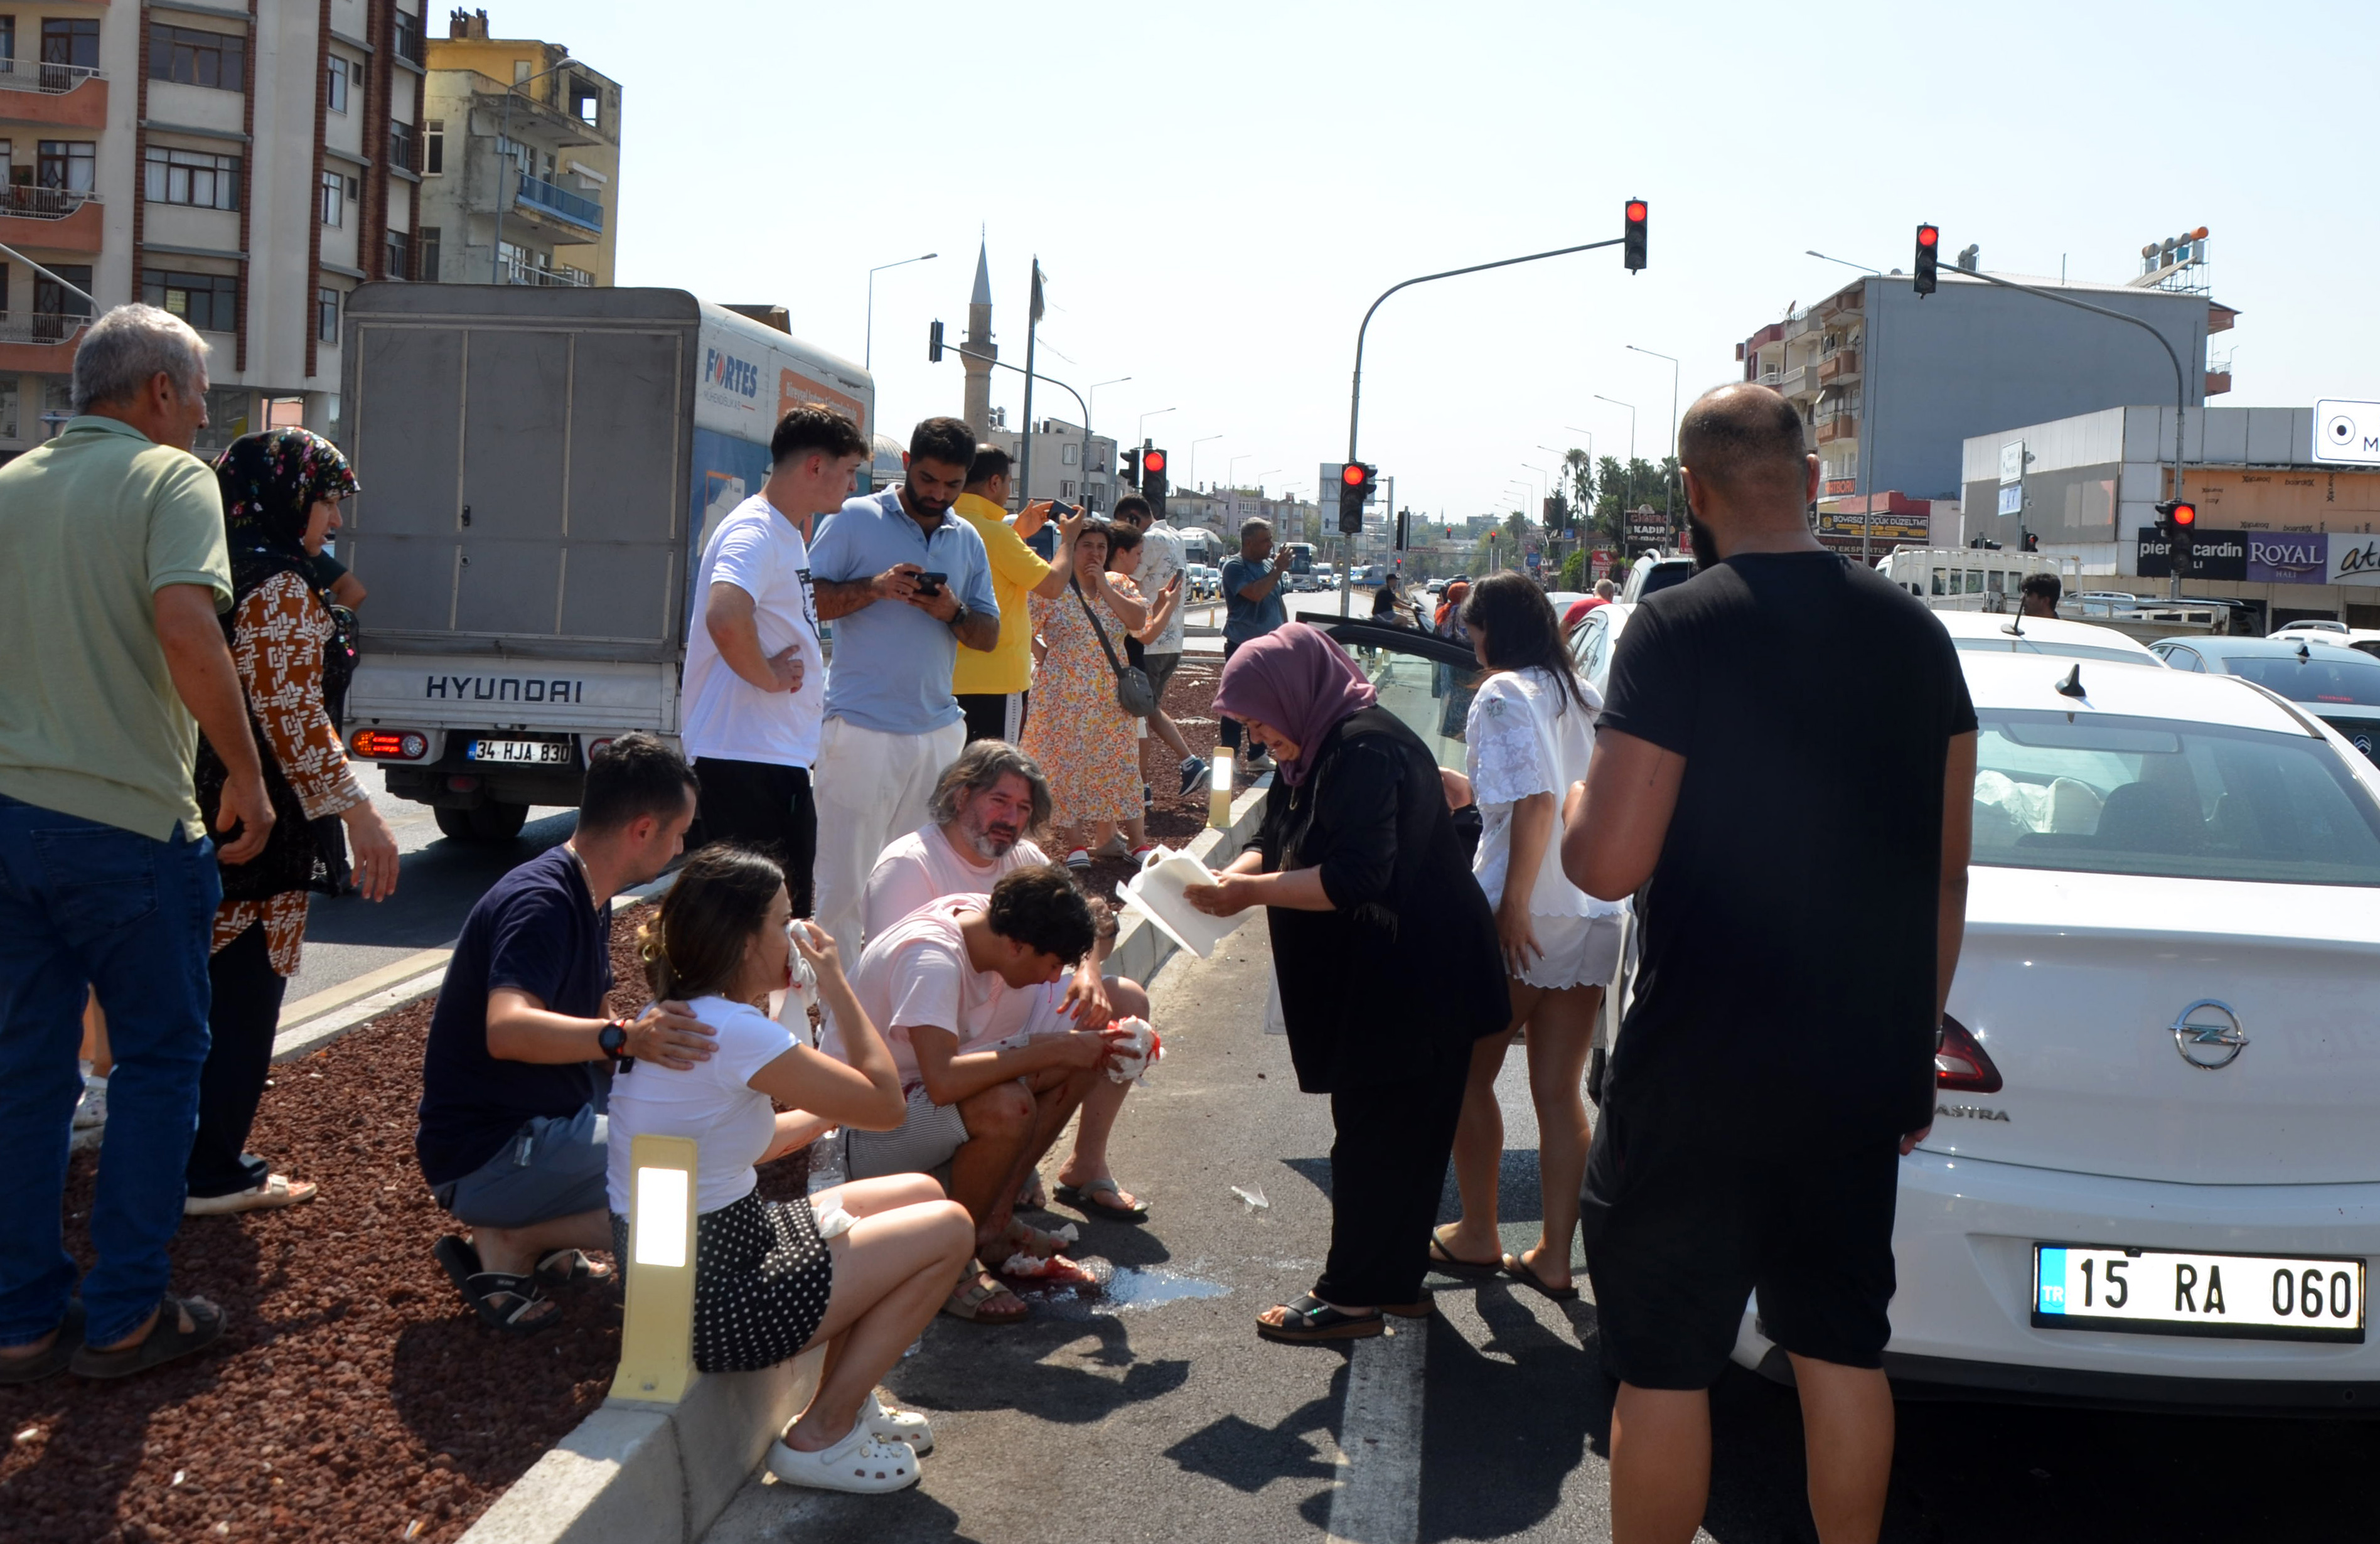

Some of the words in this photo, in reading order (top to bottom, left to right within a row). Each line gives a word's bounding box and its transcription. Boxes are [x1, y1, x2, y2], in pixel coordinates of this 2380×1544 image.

[705, 348, 758, 399] FORTES
[1833, 515, 1863, 524] BOYASIZ
[1890, 517, 1927, 526] DÜZELTME
[2193, 542, 2243, 557] cardin
[2249, 542, 2324, 566] ROYAL
[2340, 541, 2380, 571] at
[426, 675, 582, 703] HYUNDAI
[476, 741, 495, 759] 34
[503, 742, 532, 761] HJA
[540, 744, 570, 762] 830
[1934, 1103, 2011, 1122] ASTRA
[2043, 1285, 2064, 1302] TR
[2081, 1258, 2129, 1309] 15
[2175, 1263, 2226, 1314] RA
[2272, 1268, 2351, 1319] 060
